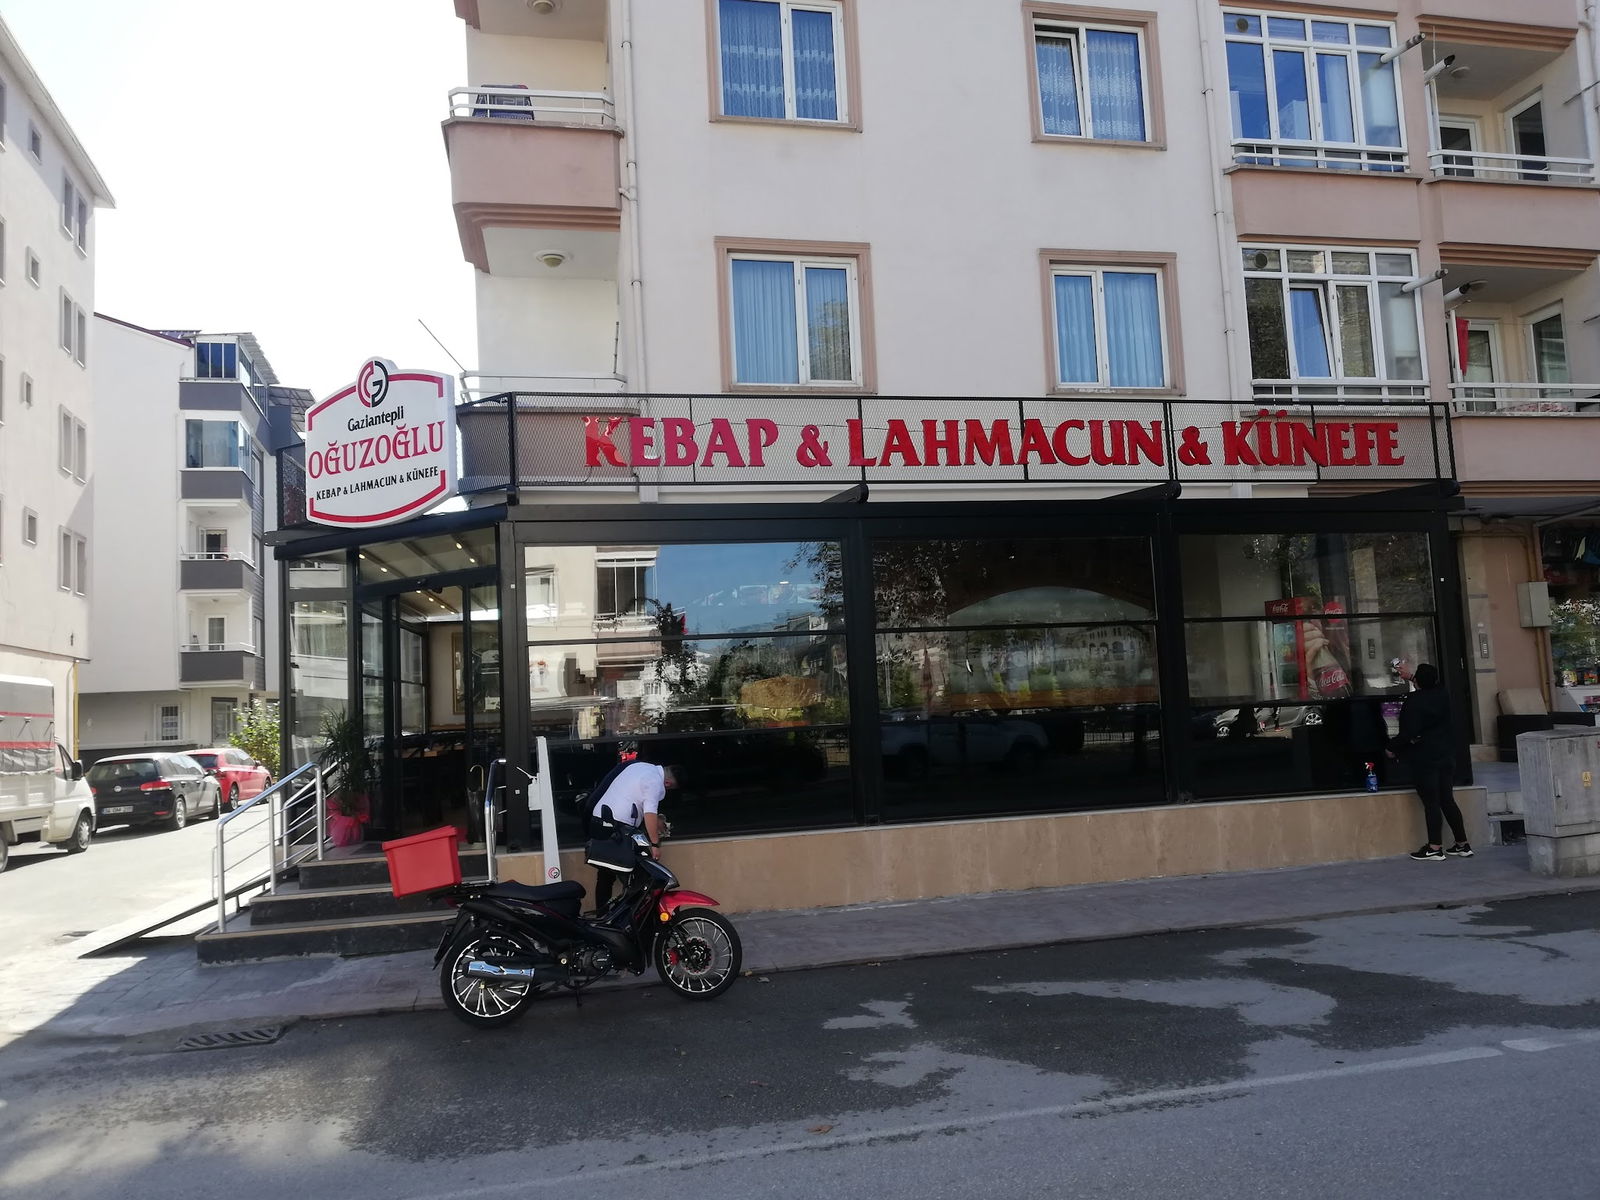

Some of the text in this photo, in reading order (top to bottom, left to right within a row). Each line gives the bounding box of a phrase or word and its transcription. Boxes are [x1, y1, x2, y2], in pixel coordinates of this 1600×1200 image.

[347, 406, 404, 432] Gaziantepli
[581, 408, 1406, 468] KEBAP & LAHMACUN & KÜNEFE
[308, 421, 446, 479] OĞUZOĞLU
[316, 466, 439, 501] KEBAP & LAHMACUN & KÜNEFE
